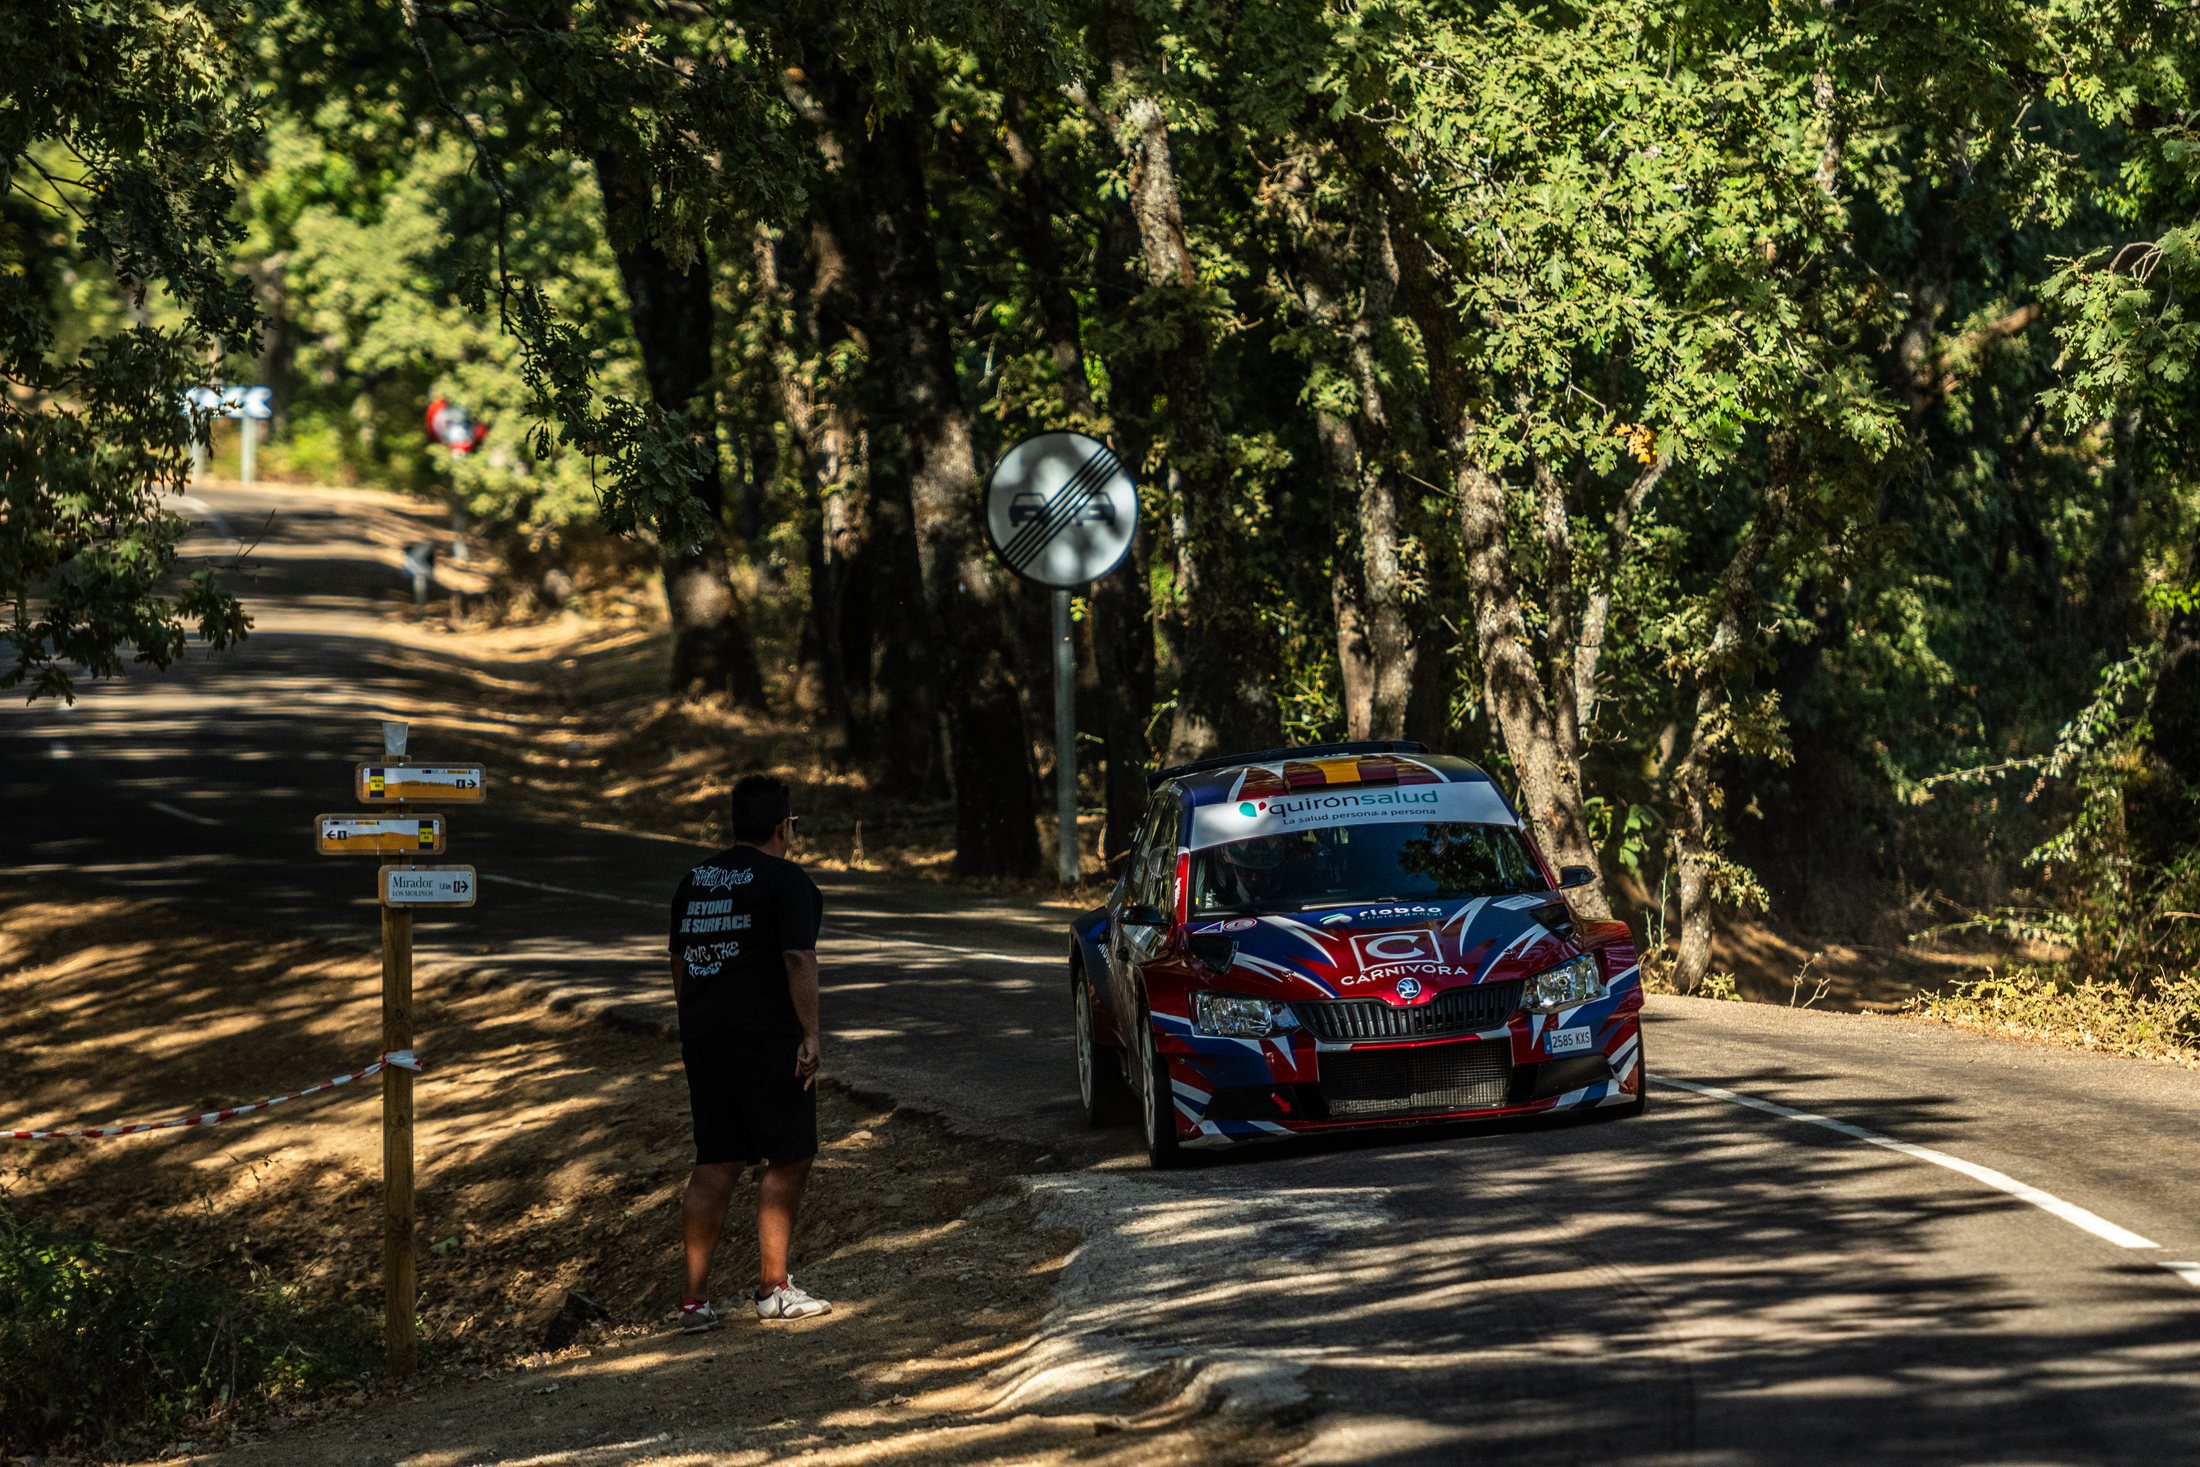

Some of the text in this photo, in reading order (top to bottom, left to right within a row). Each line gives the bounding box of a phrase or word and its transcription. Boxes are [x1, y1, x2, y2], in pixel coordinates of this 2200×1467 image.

[1282, 818, 1296, 826] La
[1298, 813, 1329, 824] salud
[1332, 810, 1377, 821] persona
[1391, 808, 1436, 818] persona
[392, 876, 433, 888] Mirador
[687, 899, 732, 915] BEYOND
[692, 914, 751, 933] SURFACE
[1365, 934, 1426, 960] C
[1340, 964, 1469, 986] CARNIVORA
[1551, 1033, 1574, 1049] 2585
[1575, 1031, 1591, 1045] KXS
